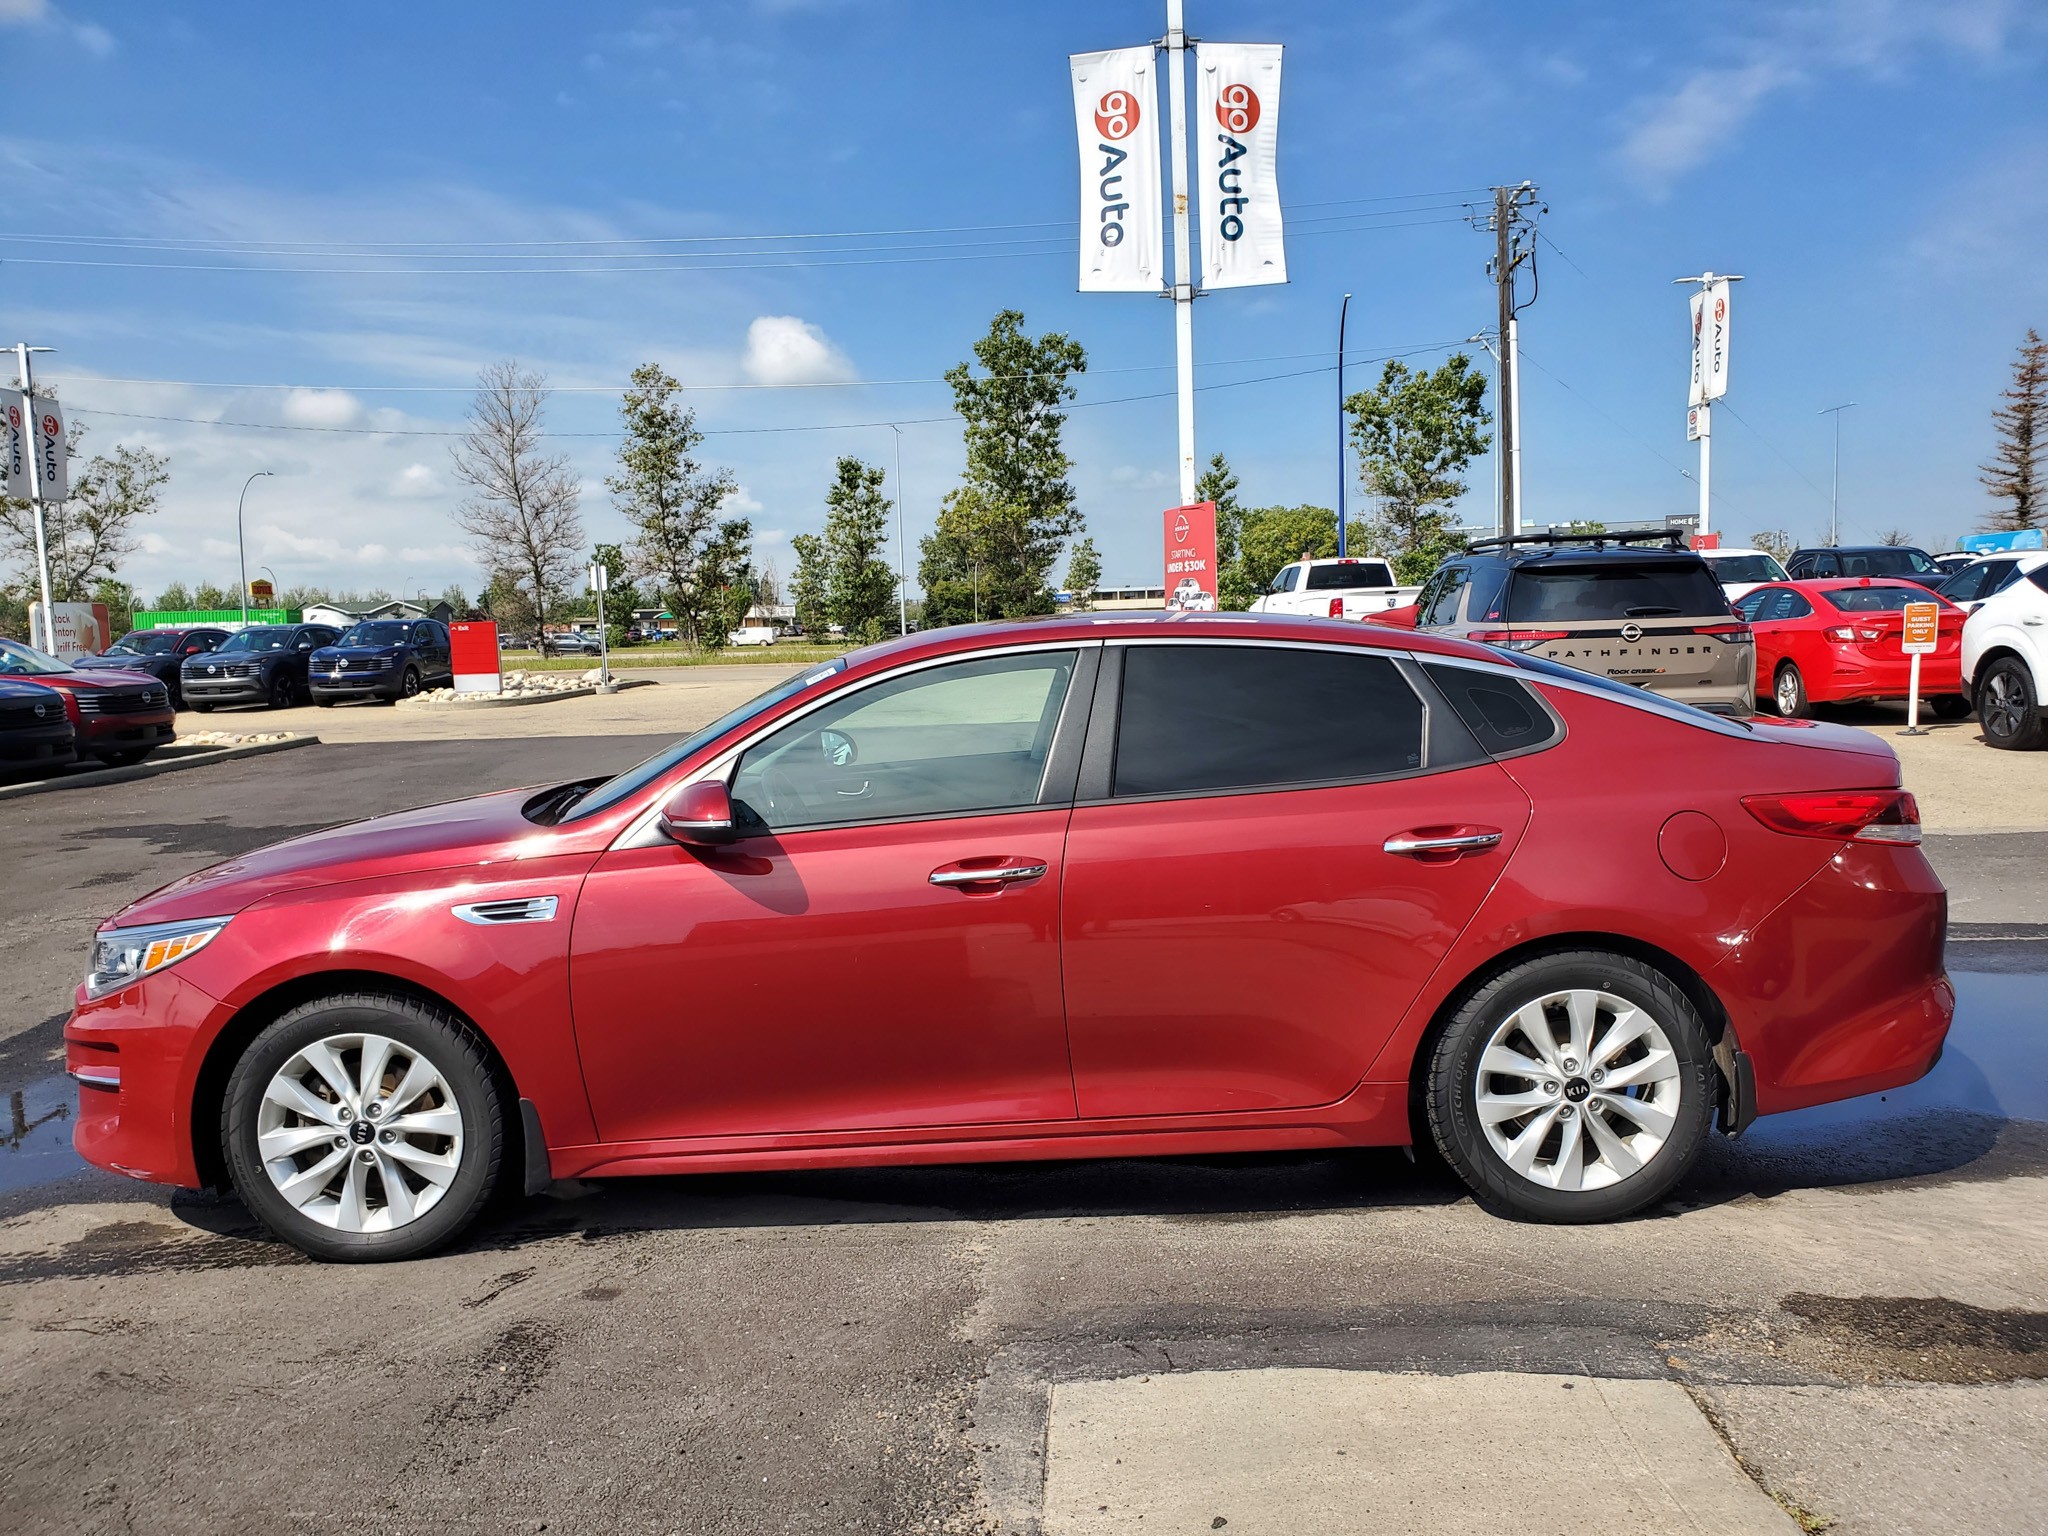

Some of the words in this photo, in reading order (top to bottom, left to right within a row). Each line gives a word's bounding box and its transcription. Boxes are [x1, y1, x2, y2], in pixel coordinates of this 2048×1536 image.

[1097, 92, 1128, 138] go
[1218, 86, 1249, 132] go
[1098, 143, 1130, 247] Auto
[1217, 134, 1250, 241] Auto
[1714, 323, 1722, 373] Auto
[9, 406, 19, 428] go
[43, 415, 55, 436] go
[11, 428, 21, 475] Auto
[44, 435, 57, 482] Auto
[1171, 548, 1196, 560] STARTING
[1184, 559, 1206, 573] $30K
[72, 642, 87, 652] Free
[1548, 646, 1712, 658] PATHFINDER
[1566, 1084, 1588, 1097] KIA
[356, 1122, 368, 1143] KIA
